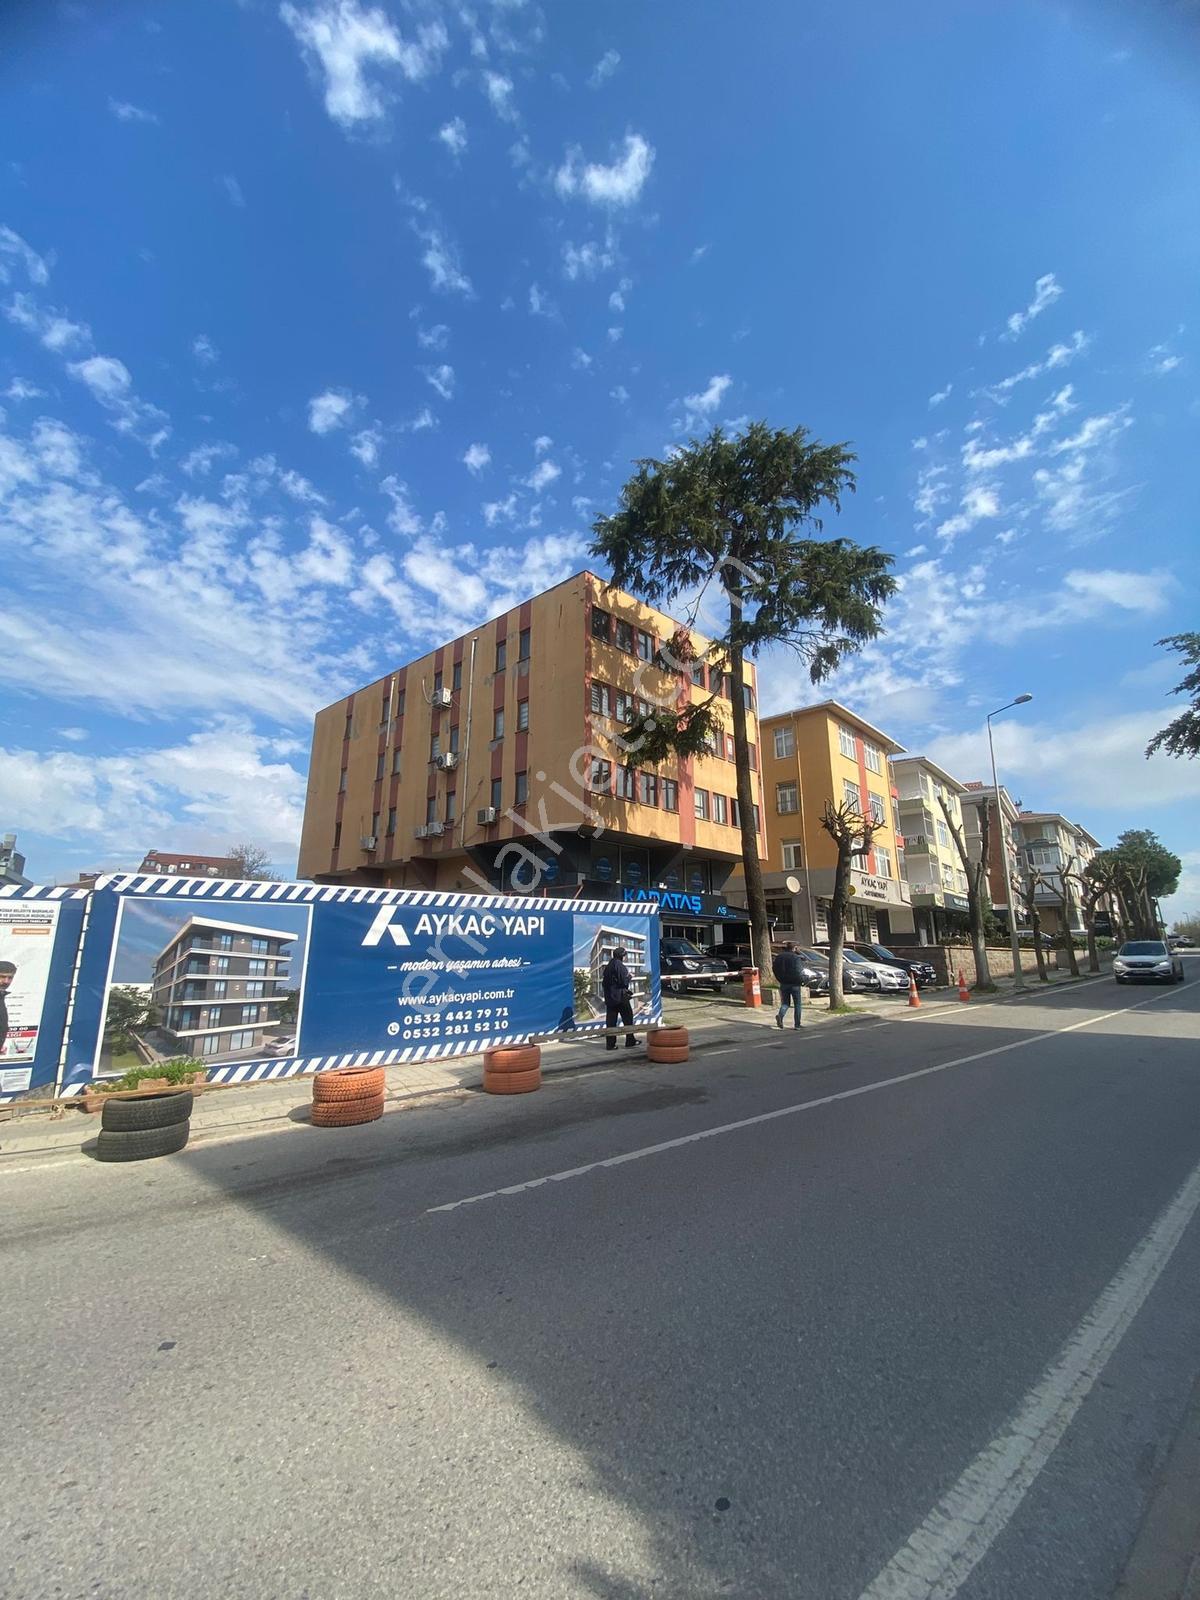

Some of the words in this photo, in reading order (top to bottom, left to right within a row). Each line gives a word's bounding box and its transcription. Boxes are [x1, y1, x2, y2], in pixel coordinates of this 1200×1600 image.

[413, 913, 496, 939] AYKAÇ
[501, 916, 545, 936] YAPI
[400, 958, 444, 972] modern
[446, 959, 491, 974] yaşamın
[492, 957, 522, 968] adresi
[398, 988, 515, 1006] www.aykacyapi.com.tr
[404, 1013, 441, 1025] 0532
[445, 1010, 473, 1021] 442
[477, 1008, 491, 1019] 79
[495, 1007, 509, 1017] 71
[402, 1027, 440, 1040] 0532
[445, 1024, 469, 1035] 281
[474, 1022, 490, 1032] 52
[494, 1020, 508, 1030] 10
